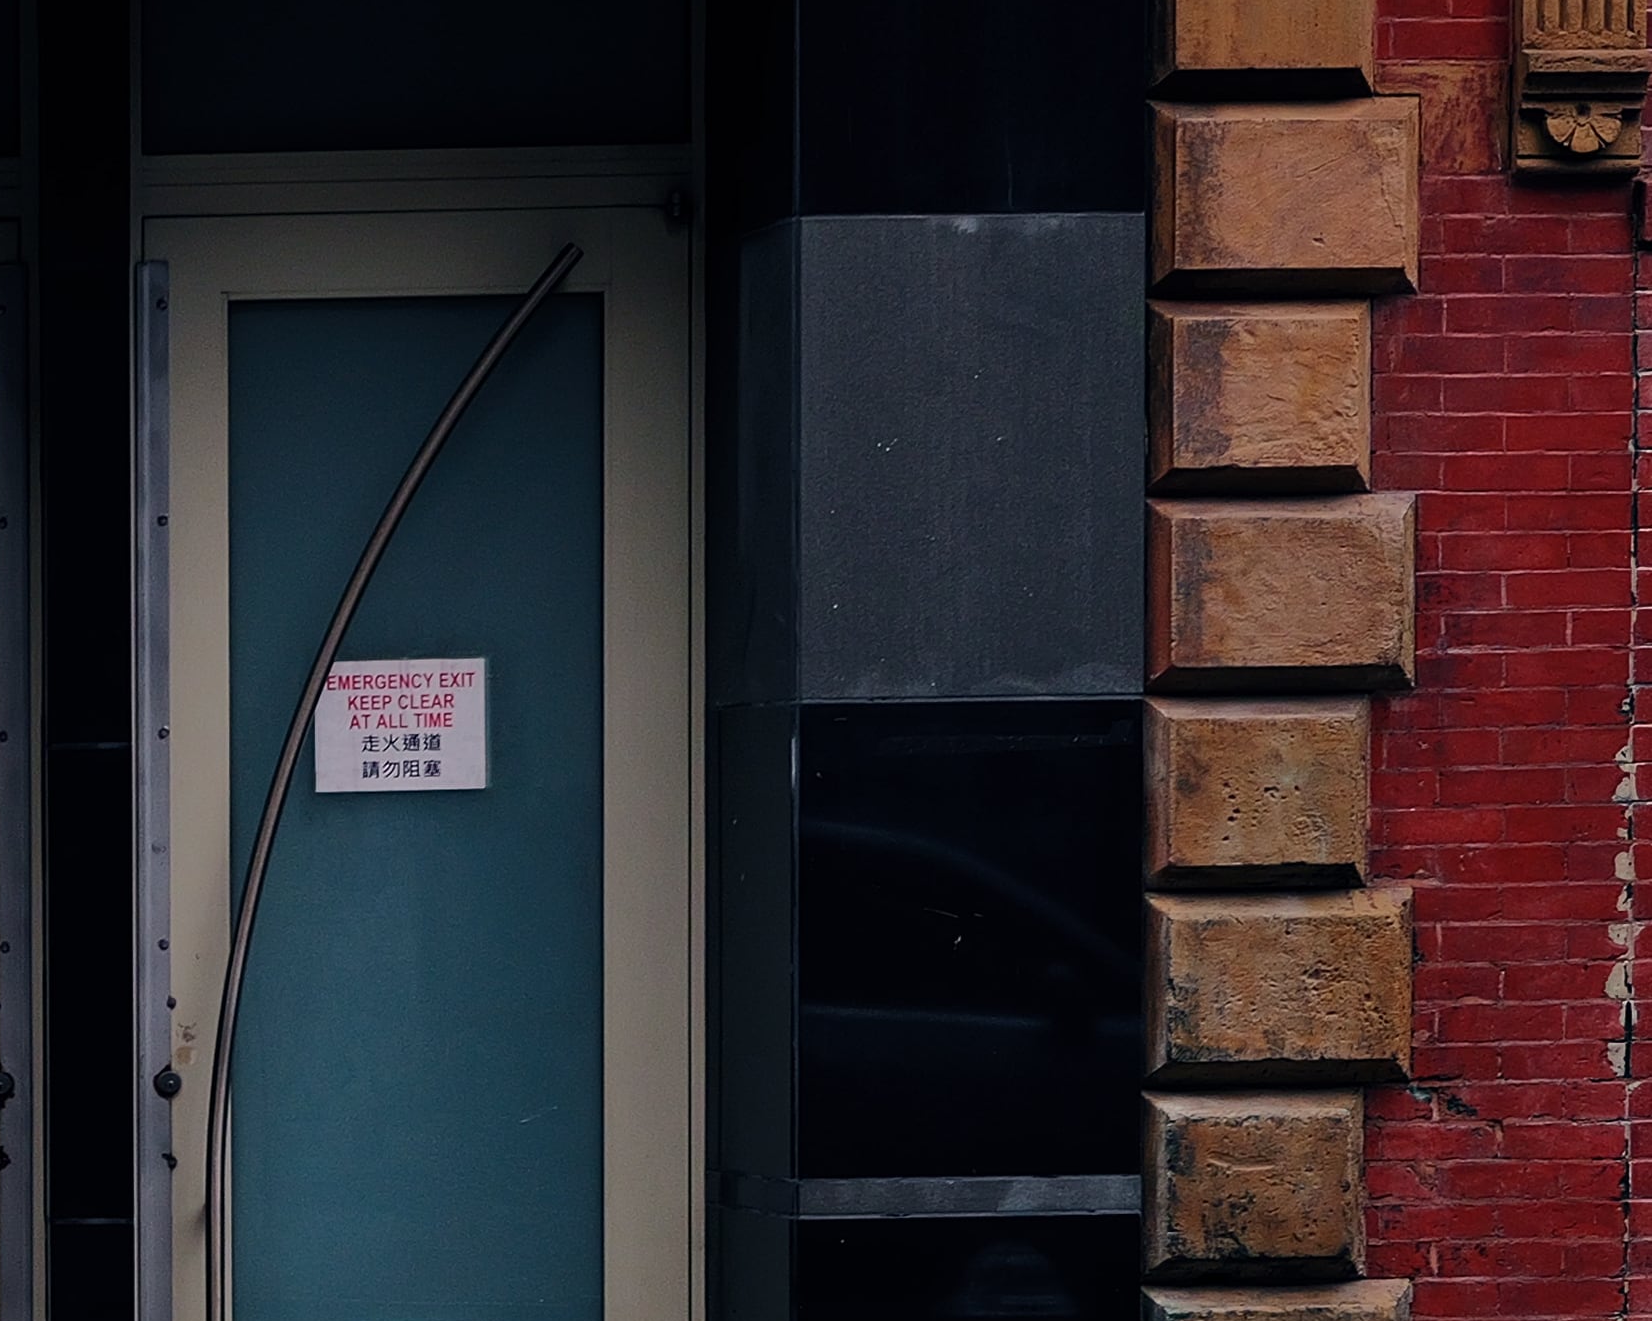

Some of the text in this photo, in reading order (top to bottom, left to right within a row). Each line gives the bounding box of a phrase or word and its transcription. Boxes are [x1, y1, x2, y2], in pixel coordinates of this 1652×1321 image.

[326, 672, 476, 691] EMERGENCY EXIT
[348, 694, 455, 711] KEEP CLEAR
[349, 712, 454, 730] AT ALL TIME
[361, 734, 442, 753] 走火通道
[362, 760, 442, 779] 請勿阻塞
